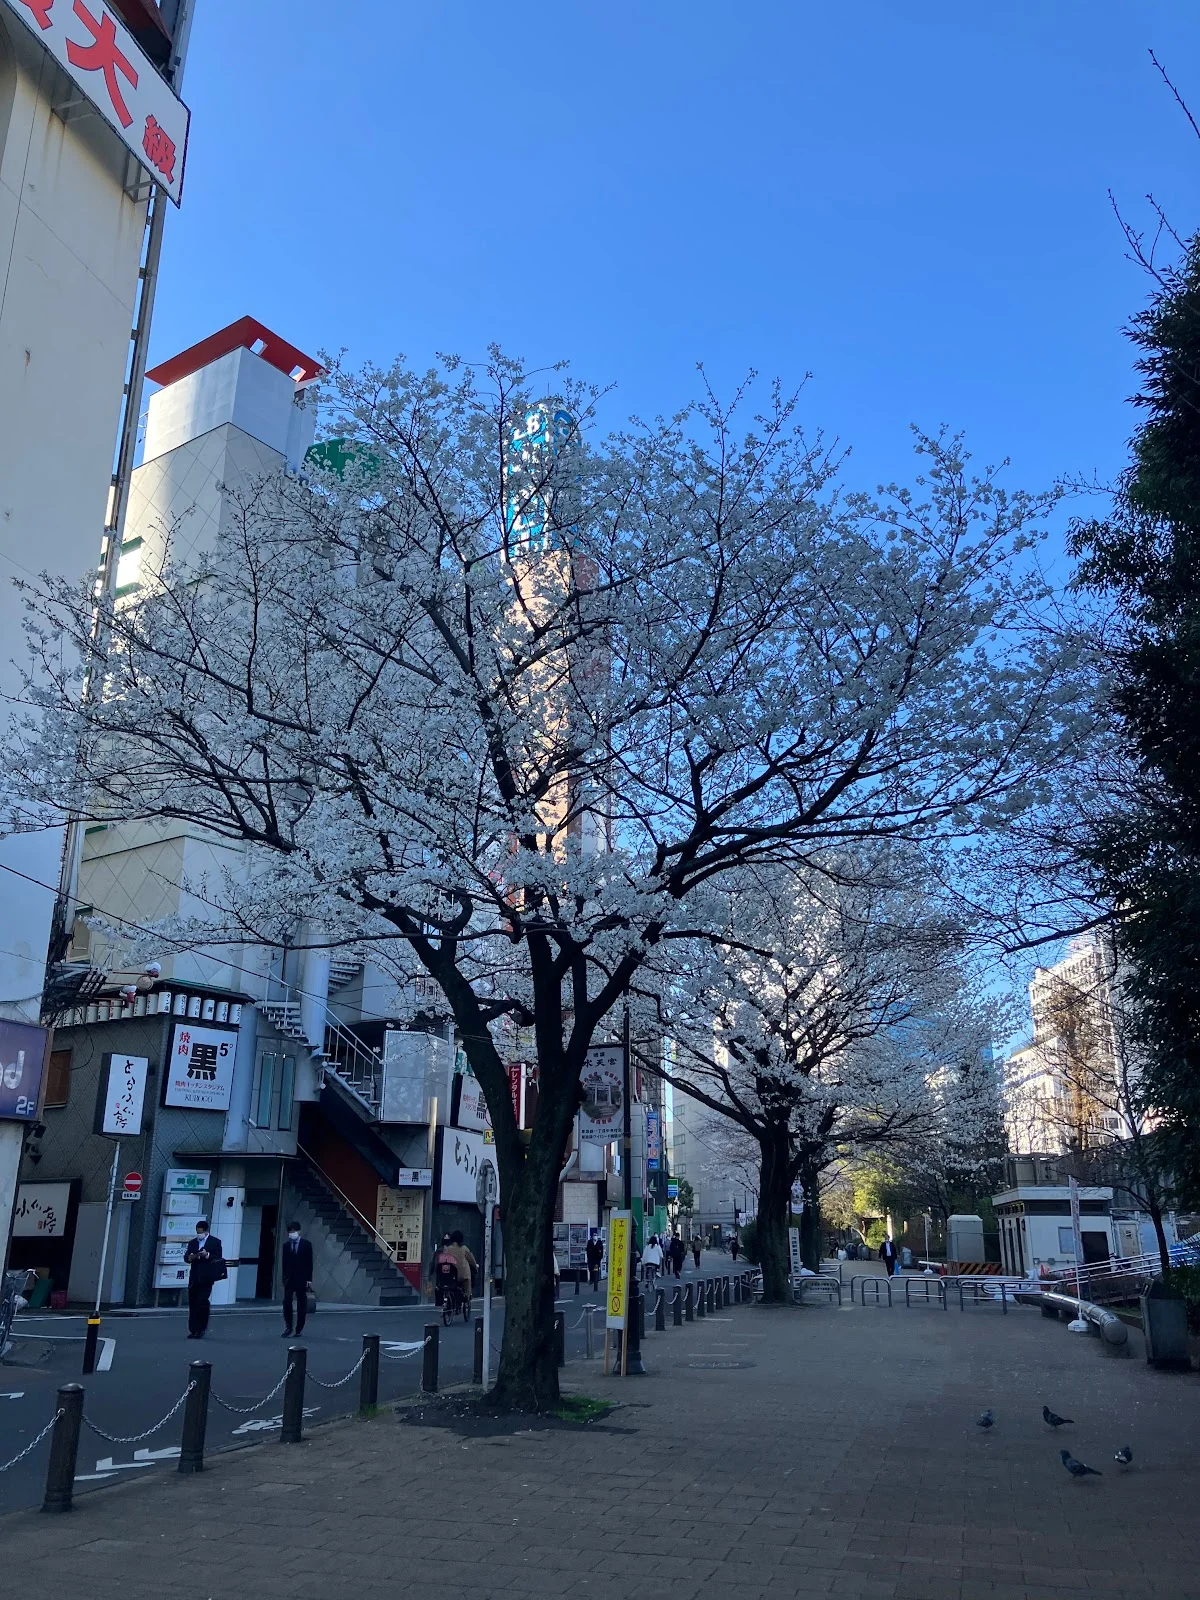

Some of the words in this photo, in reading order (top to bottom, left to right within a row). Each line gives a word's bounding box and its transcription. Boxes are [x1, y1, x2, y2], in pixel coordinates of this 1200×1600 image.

[178, 1031, 191, 1056] 焼肉
[187, 1043, 218, 1081] 黒
[582, 1057, 617, 1069] 水天宮
[15, 1095, 35, 1115] 2F
[113, 1059, 136, 1129] とらふぐ亭
